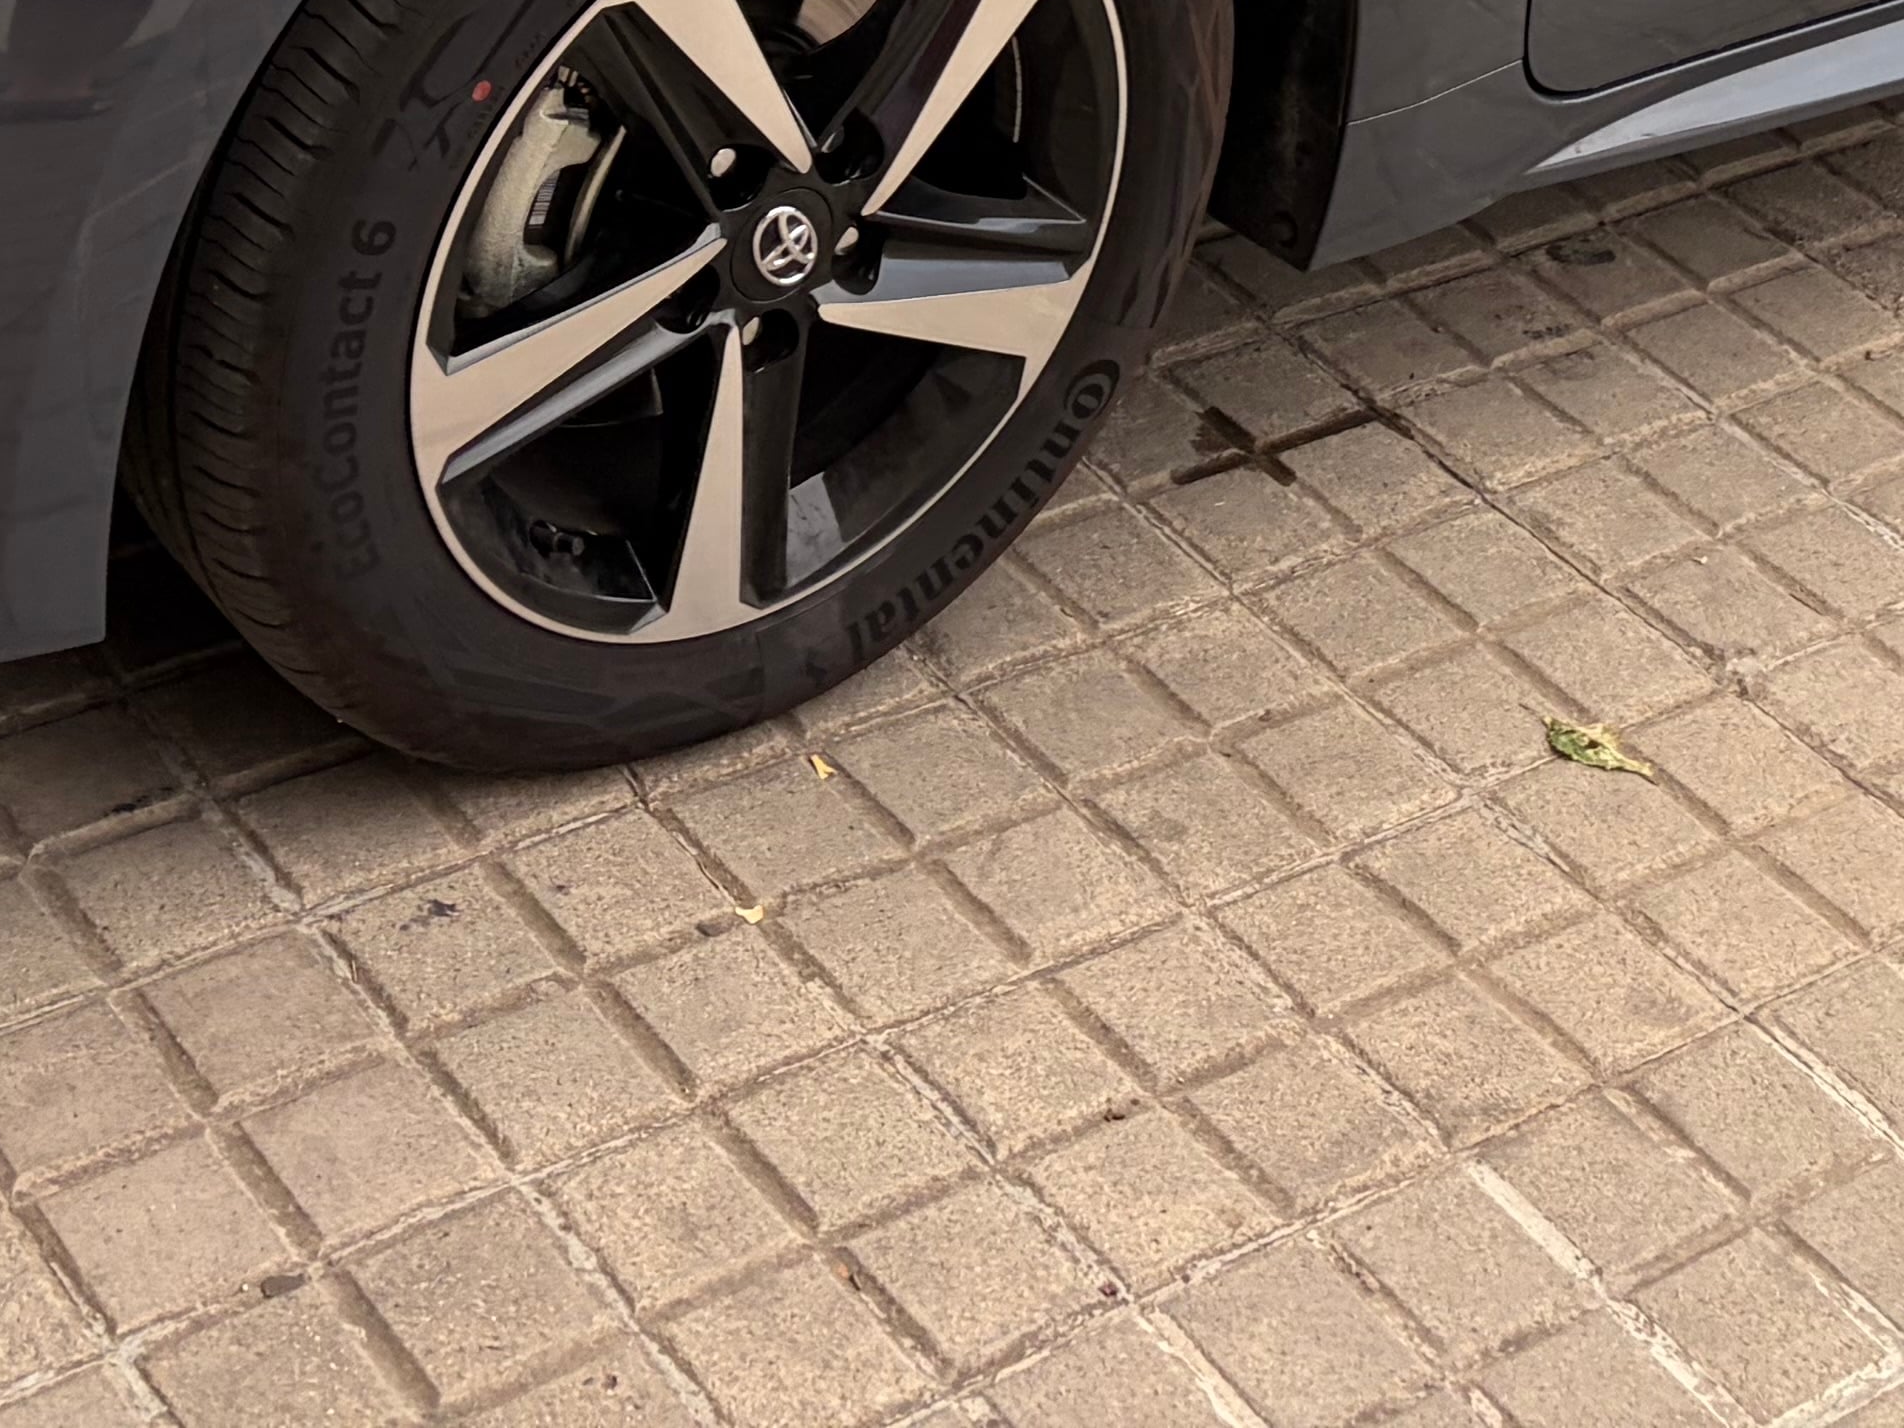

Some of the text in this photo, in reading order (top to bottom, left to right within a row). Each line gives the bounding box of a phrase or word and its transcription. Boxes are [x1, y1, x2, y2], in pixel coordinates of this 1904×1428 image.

[313, 218, 397, 578] EcoContact 6
[847, 359, 1121, 661] Continental
